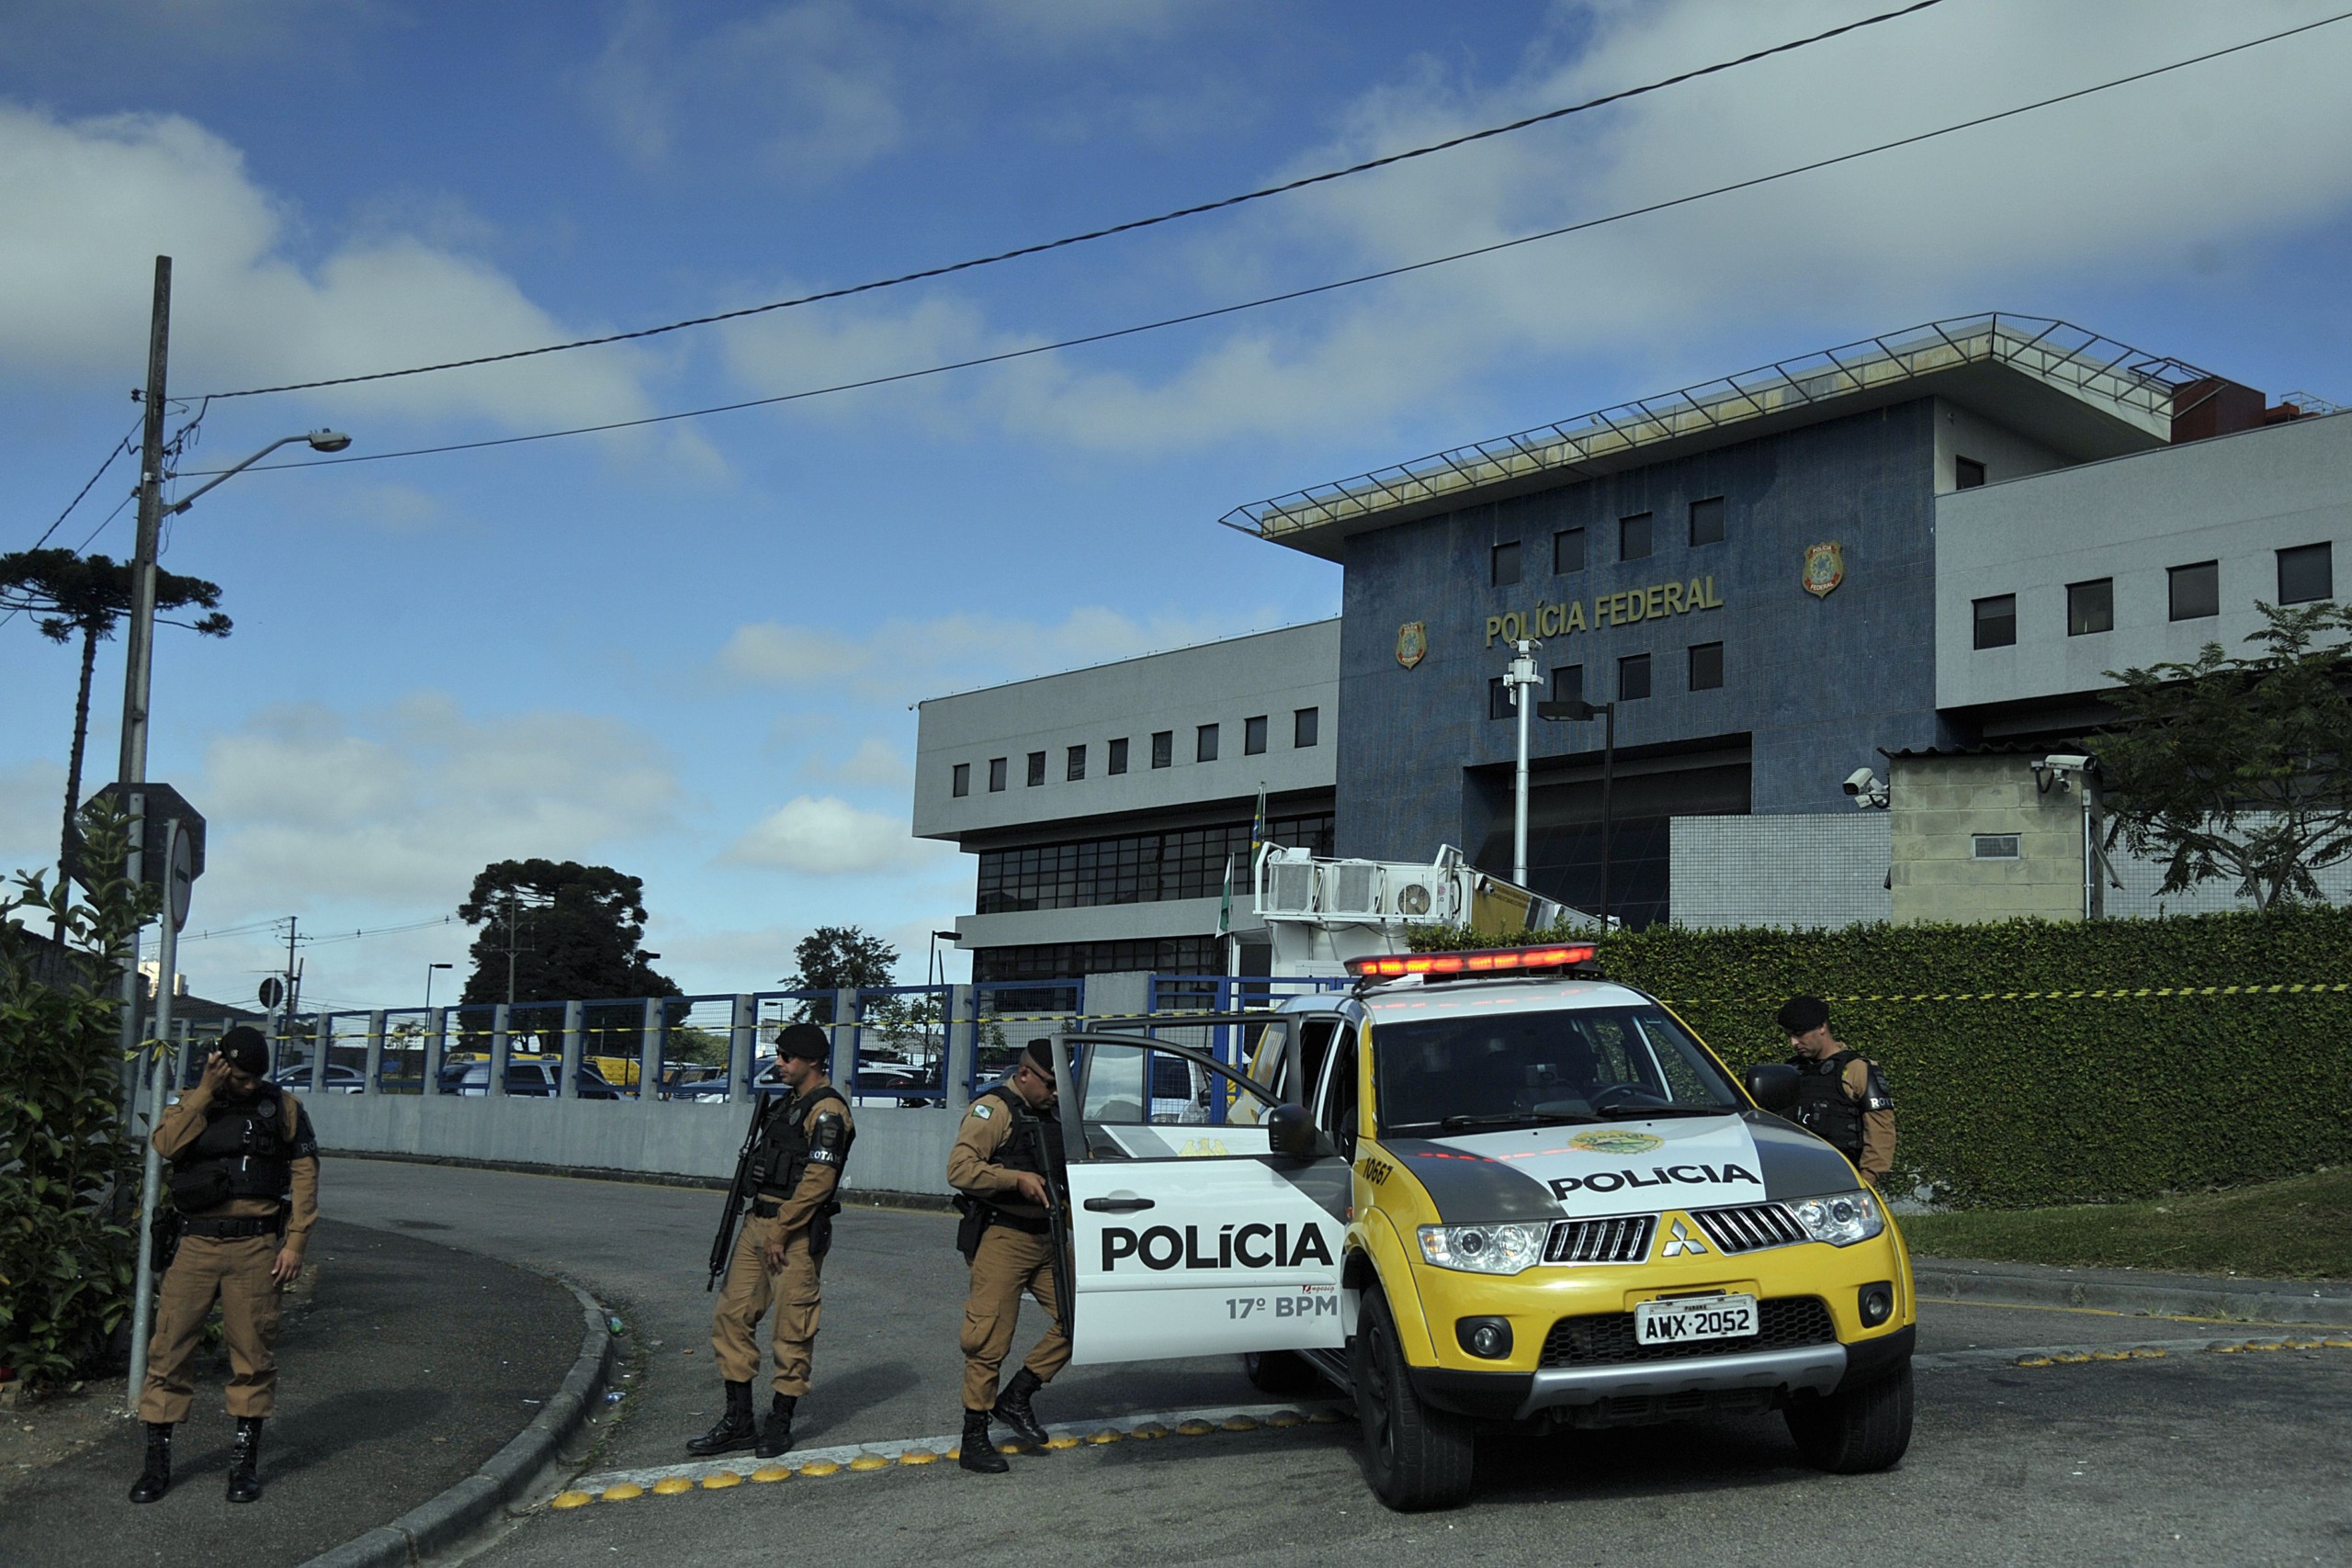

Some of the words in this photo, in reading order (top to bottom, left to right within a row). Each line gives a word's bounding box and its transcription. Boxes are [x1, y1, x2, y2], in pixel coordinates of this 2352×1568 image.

[1810, 581, 1834, 591] FEDERAL
[1486, 600, 1587, 648] POLÍCIA
[1594, 576, 1723, 628] FEDERAL
[1363, 1157, 1394, 1186] 10667
[1547, 1164, 1762, 1201] POLÍCIA
[1102, 1223, 1334, 1271] POLÍCIA
[1226, 1298, 1266, 1319] 17º
[1275, 1295, 1338, 1317] BPM
